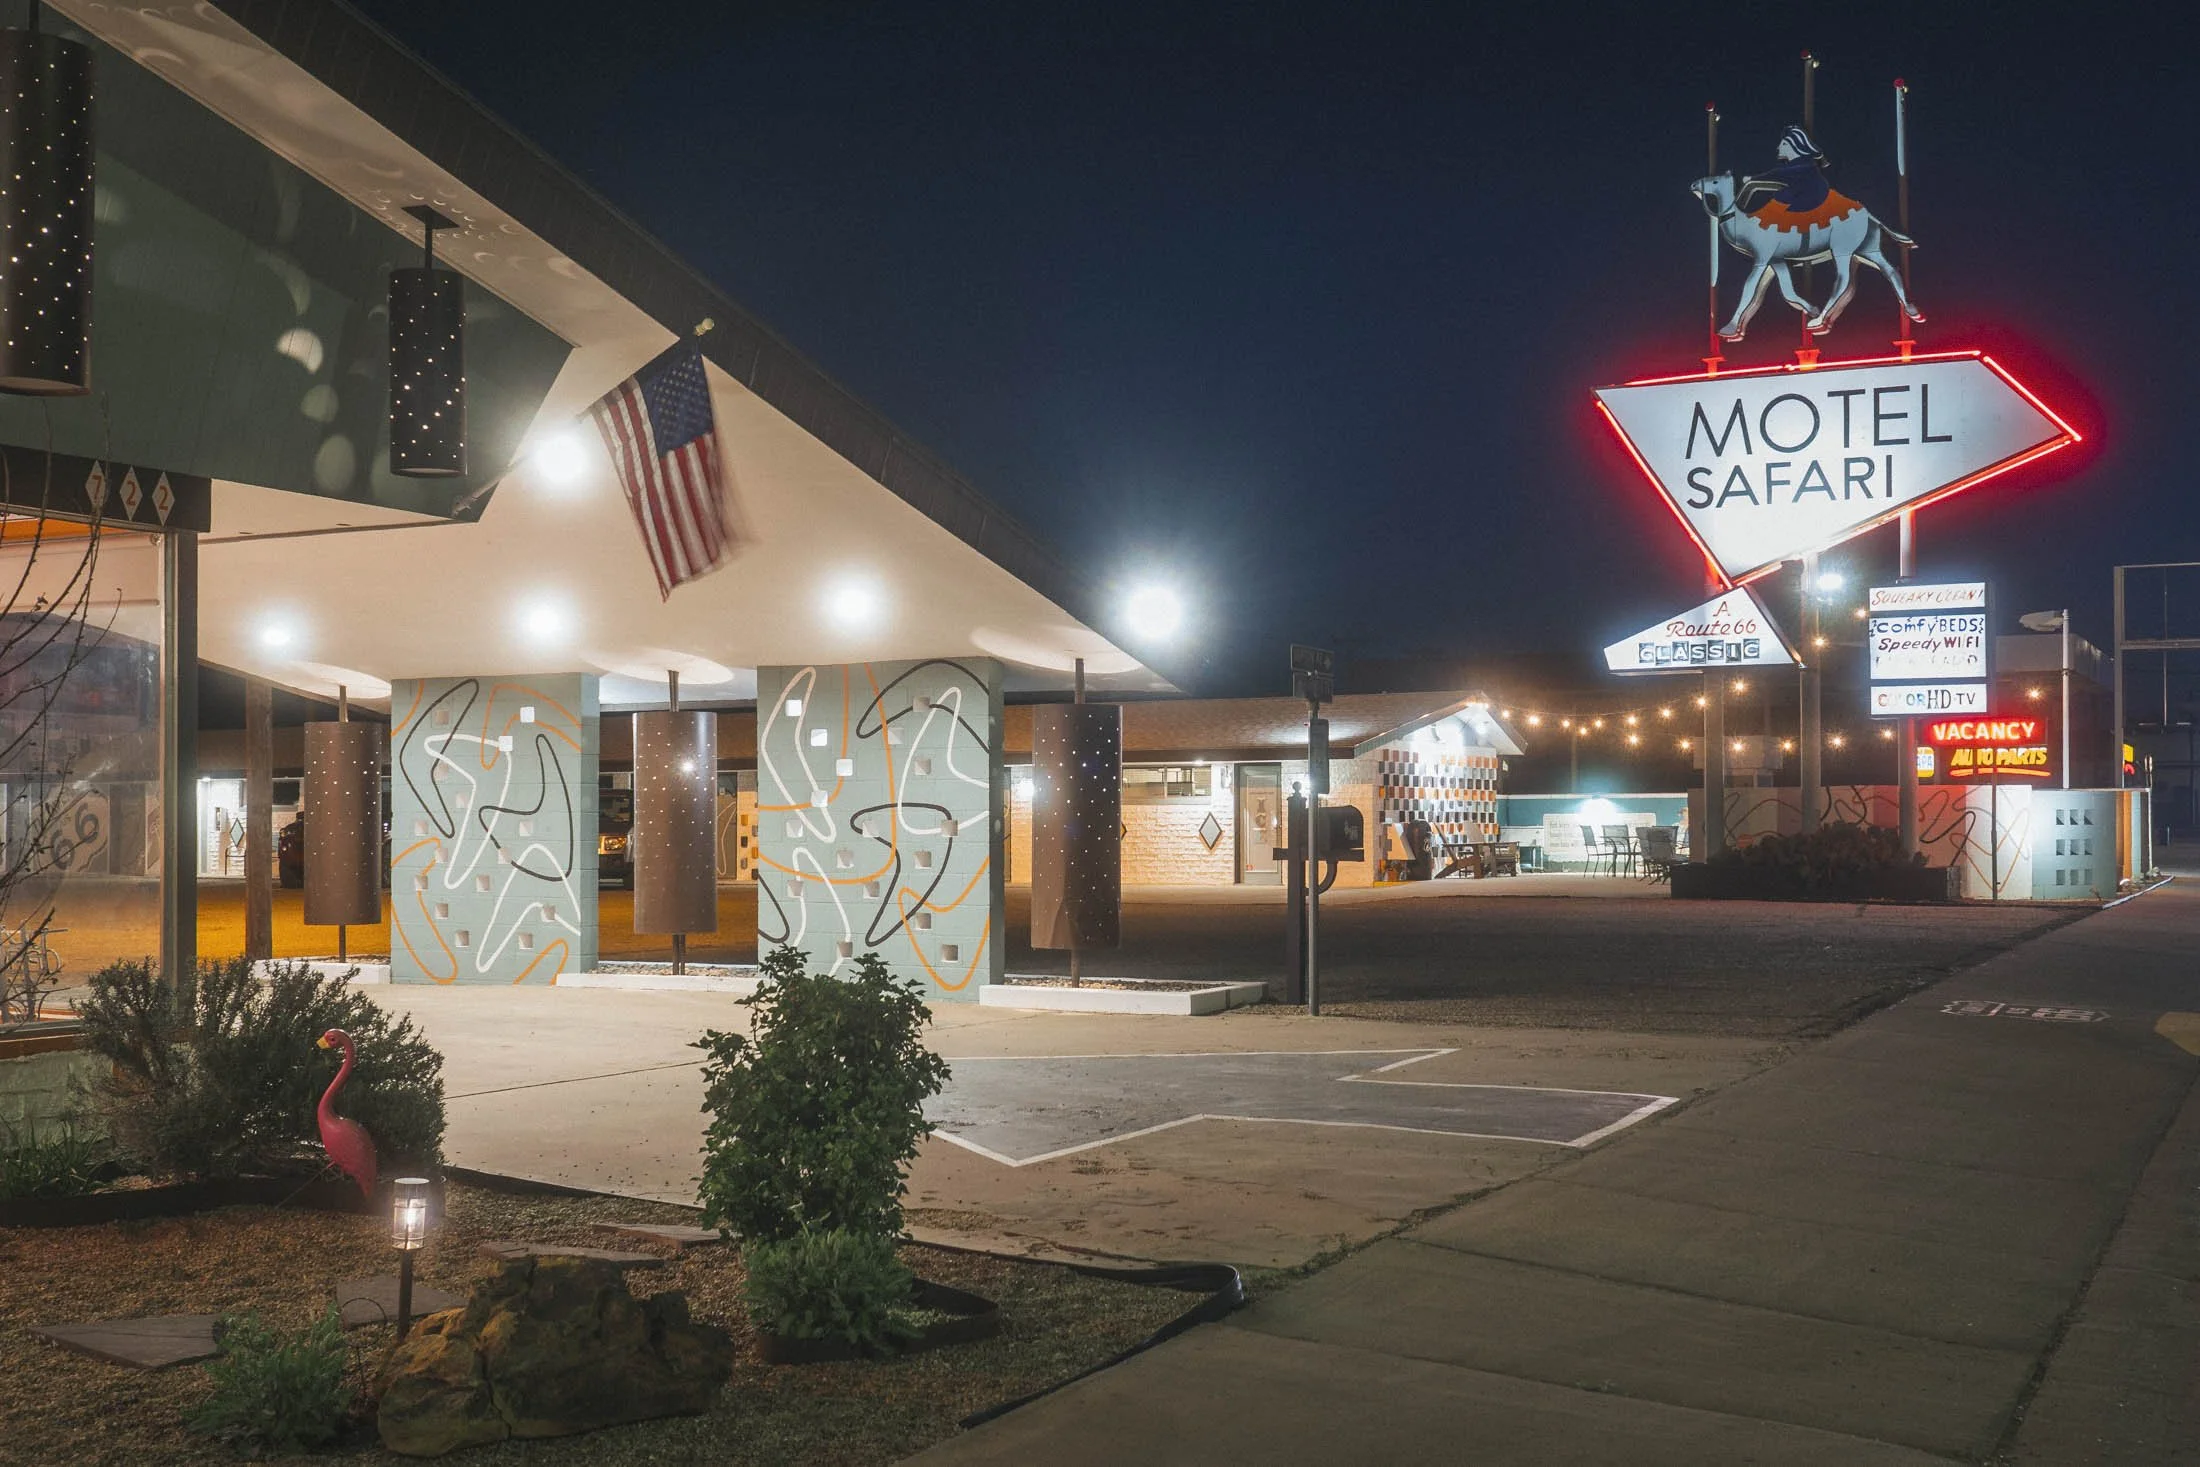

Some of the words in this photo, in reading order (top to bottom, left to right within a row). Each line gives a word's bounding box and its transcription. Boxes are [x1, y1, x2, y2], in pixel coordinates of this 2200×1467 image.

[1685, 384, 1953, 460] MOTEL
[1686, 454, 1893, 510] SAFARI
[1871, 590, 1934, 606] SQUEAKY
[1713, 601, 1731, 617] A
[1666, 620, 1731, 638] Route
[1733, 619, 1757, 635] 66
[1876, 618, 1937, 636] Comfy
[1939, 618, 1978, 633] BEDS
[1878, 638, 1941, 653] Speedy
[1878, 693, 1926, 707] COR
[1933, 722, 2035, 741] VACANCY
[1951, 748, 1995, 767] AUTO
[1996, 747, 2047, 766] PARTS
